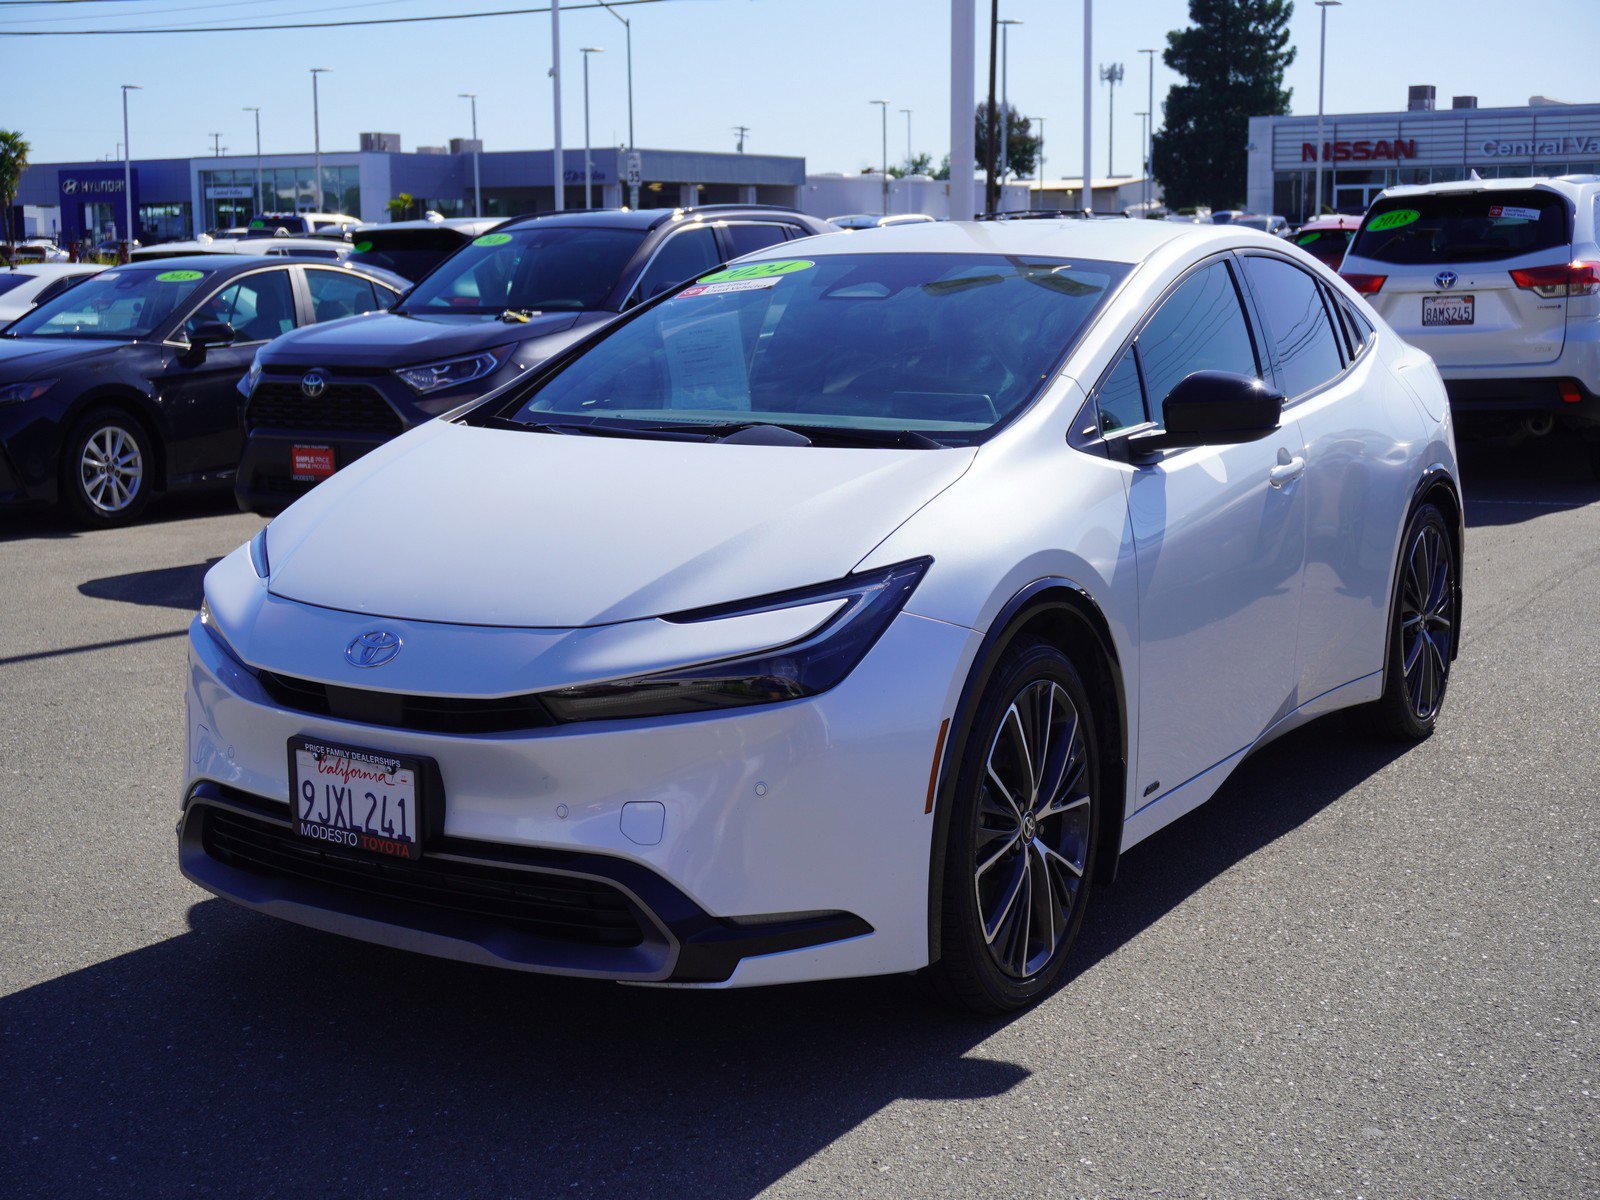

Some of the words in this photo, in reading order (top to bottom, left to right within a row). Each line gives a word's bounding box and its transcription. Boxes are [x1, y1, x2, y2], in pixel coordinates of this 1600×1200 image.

[1302, 139, 1415, 161] NISSAN
[1480, 137, 1565, 157] Central
[1571, 136, 1600, 154] Va
[81, 180, 125, 193] HYUNDAI
[1375, 211, 1410, 228] 2018
[708, 261, 799, 282] 2024
[1425, 306, 1470, 321] 8AMS245
[304, 743, 325, 754] PRICE
[326, 747, 350, 759] FAMILY
[351, 752, 401, 768] DEALERSHIPS
[318, 754, 395, 786] California
[302, 780, 411, 843] 9JXL241
[301, 823, 357, 846] MODESTO
[361, 835, 409, 857] TOYOTA
